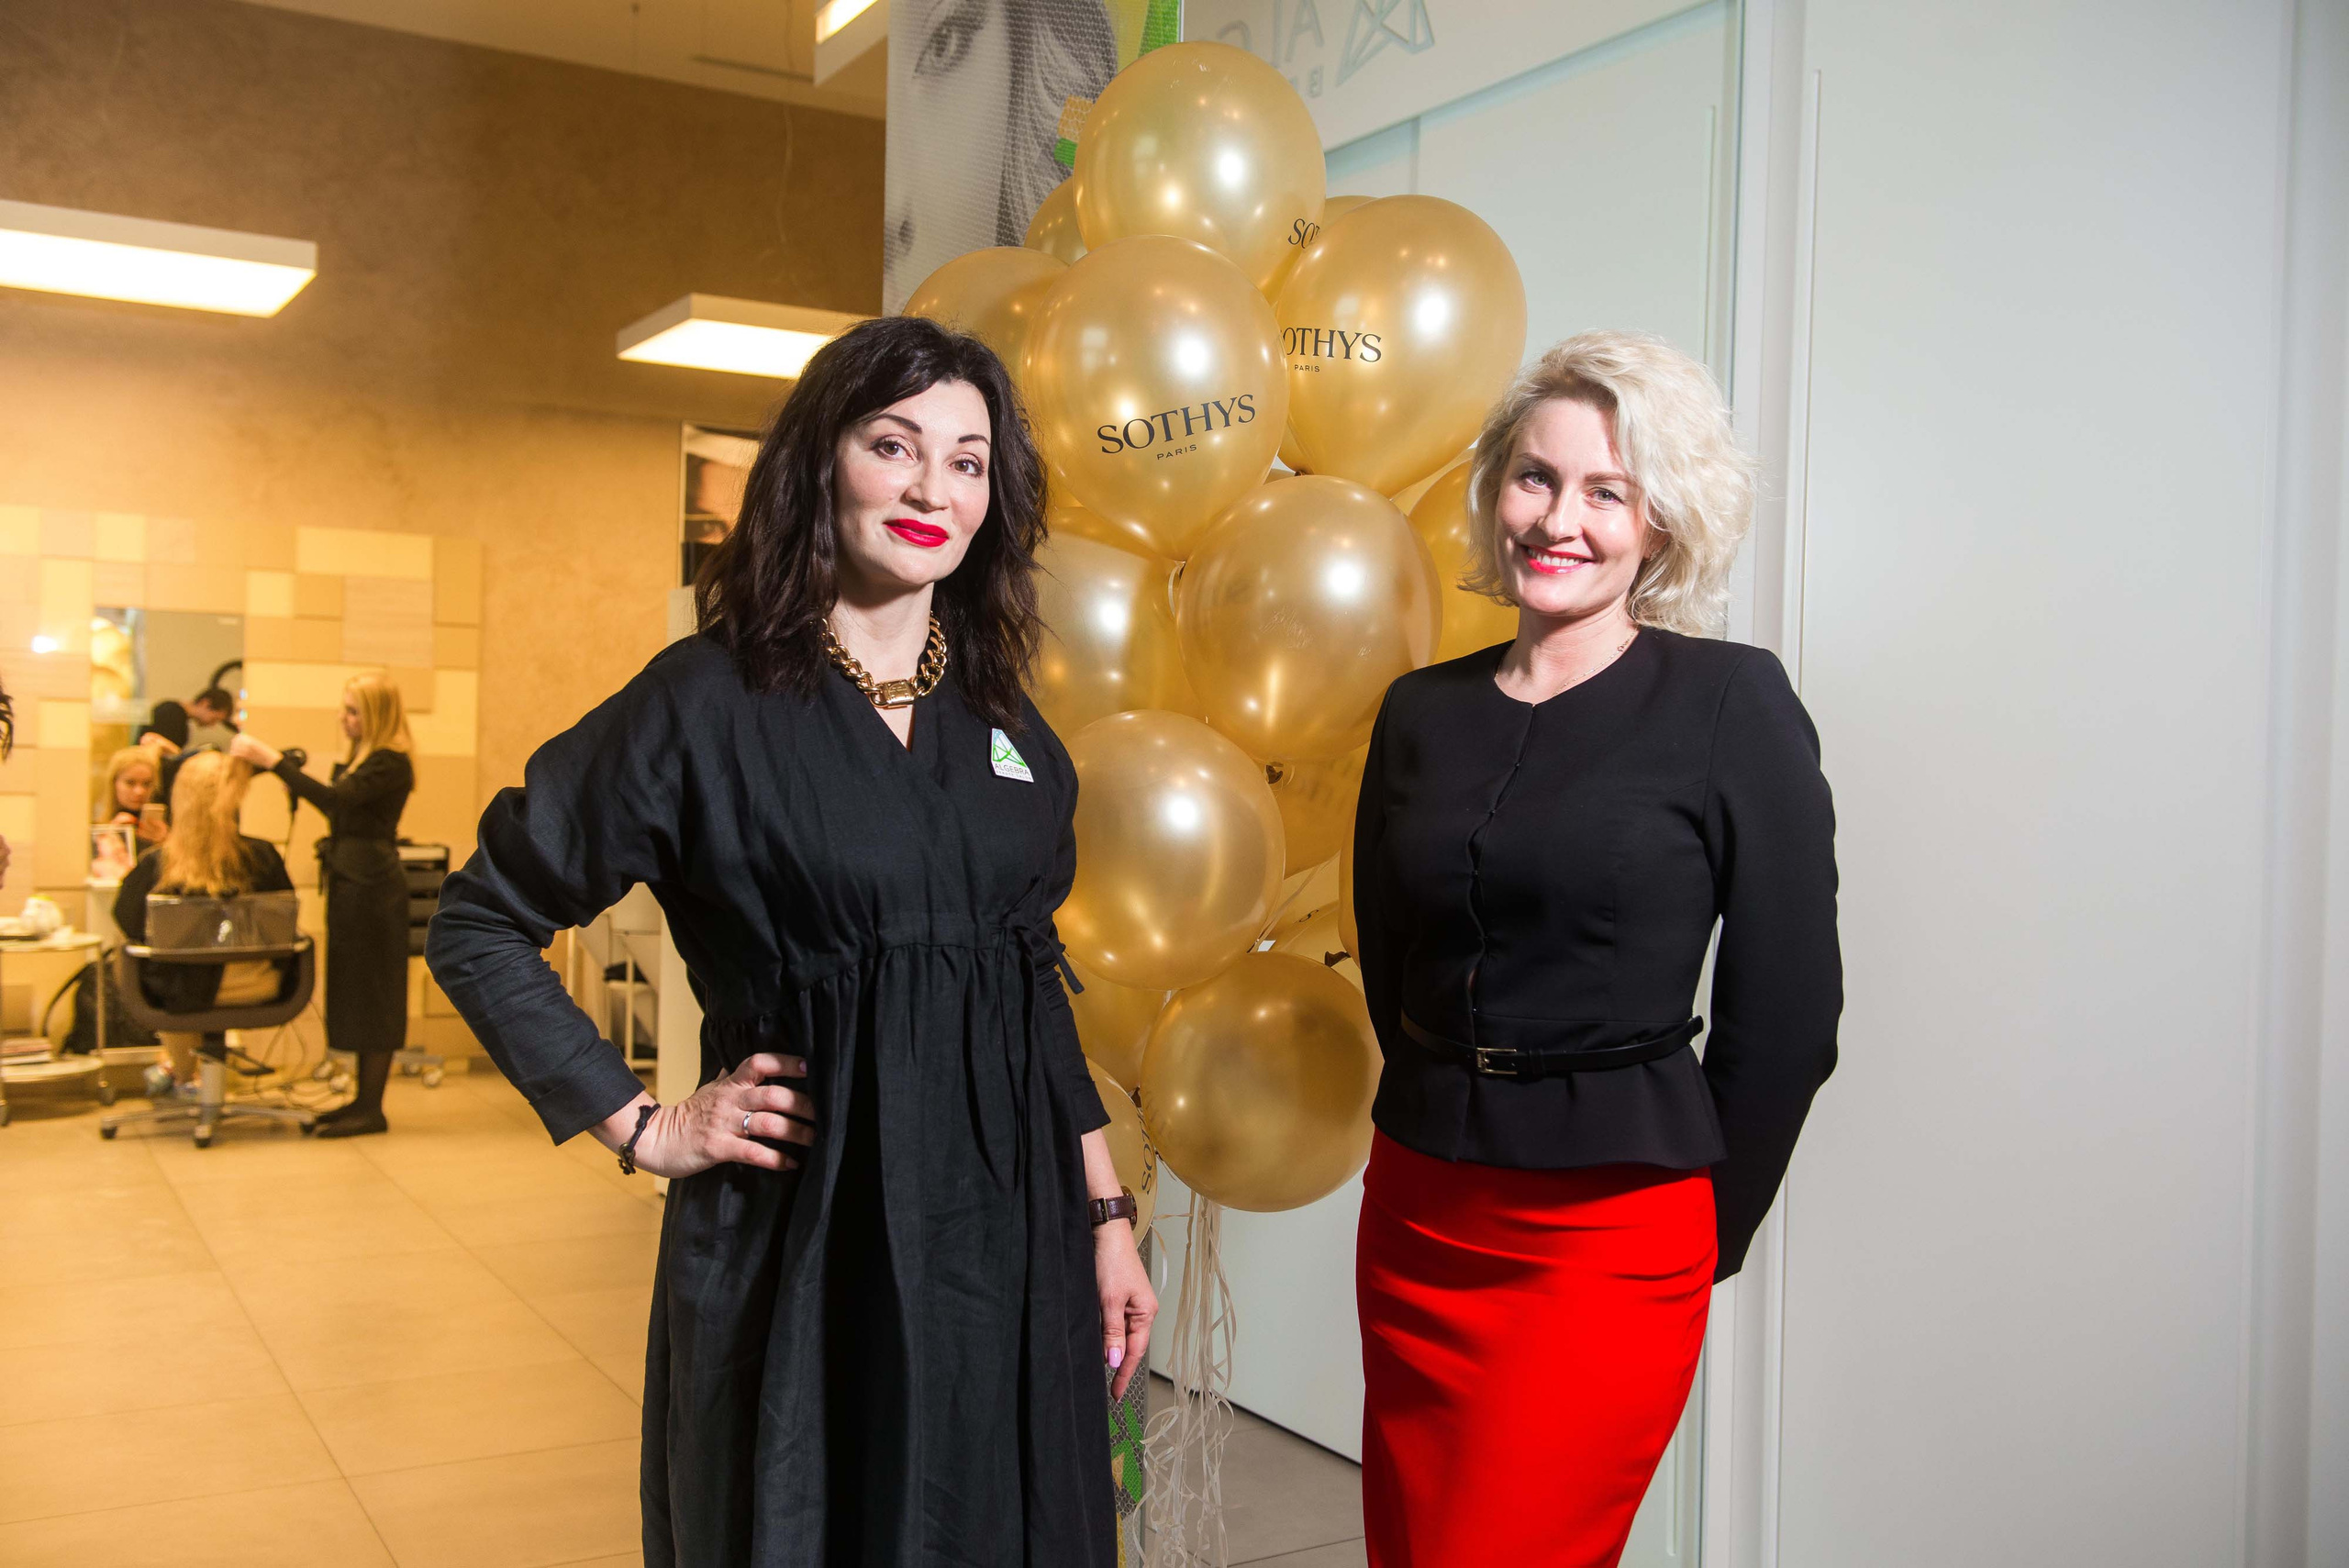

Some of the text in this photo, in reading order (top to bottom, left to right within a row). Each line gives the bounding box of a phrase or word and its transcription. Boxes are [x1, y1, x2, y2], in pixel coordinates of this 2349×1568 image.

[1280, 327, 1382, 363] OTHYS
[1294, 363, 1320, 373] PARIS
[1097, 394, 1255, 454] SOTHYS
[1156, 444, 1197, 461] PARIS
[995, 762, 1030, 776] ALGEBRA
